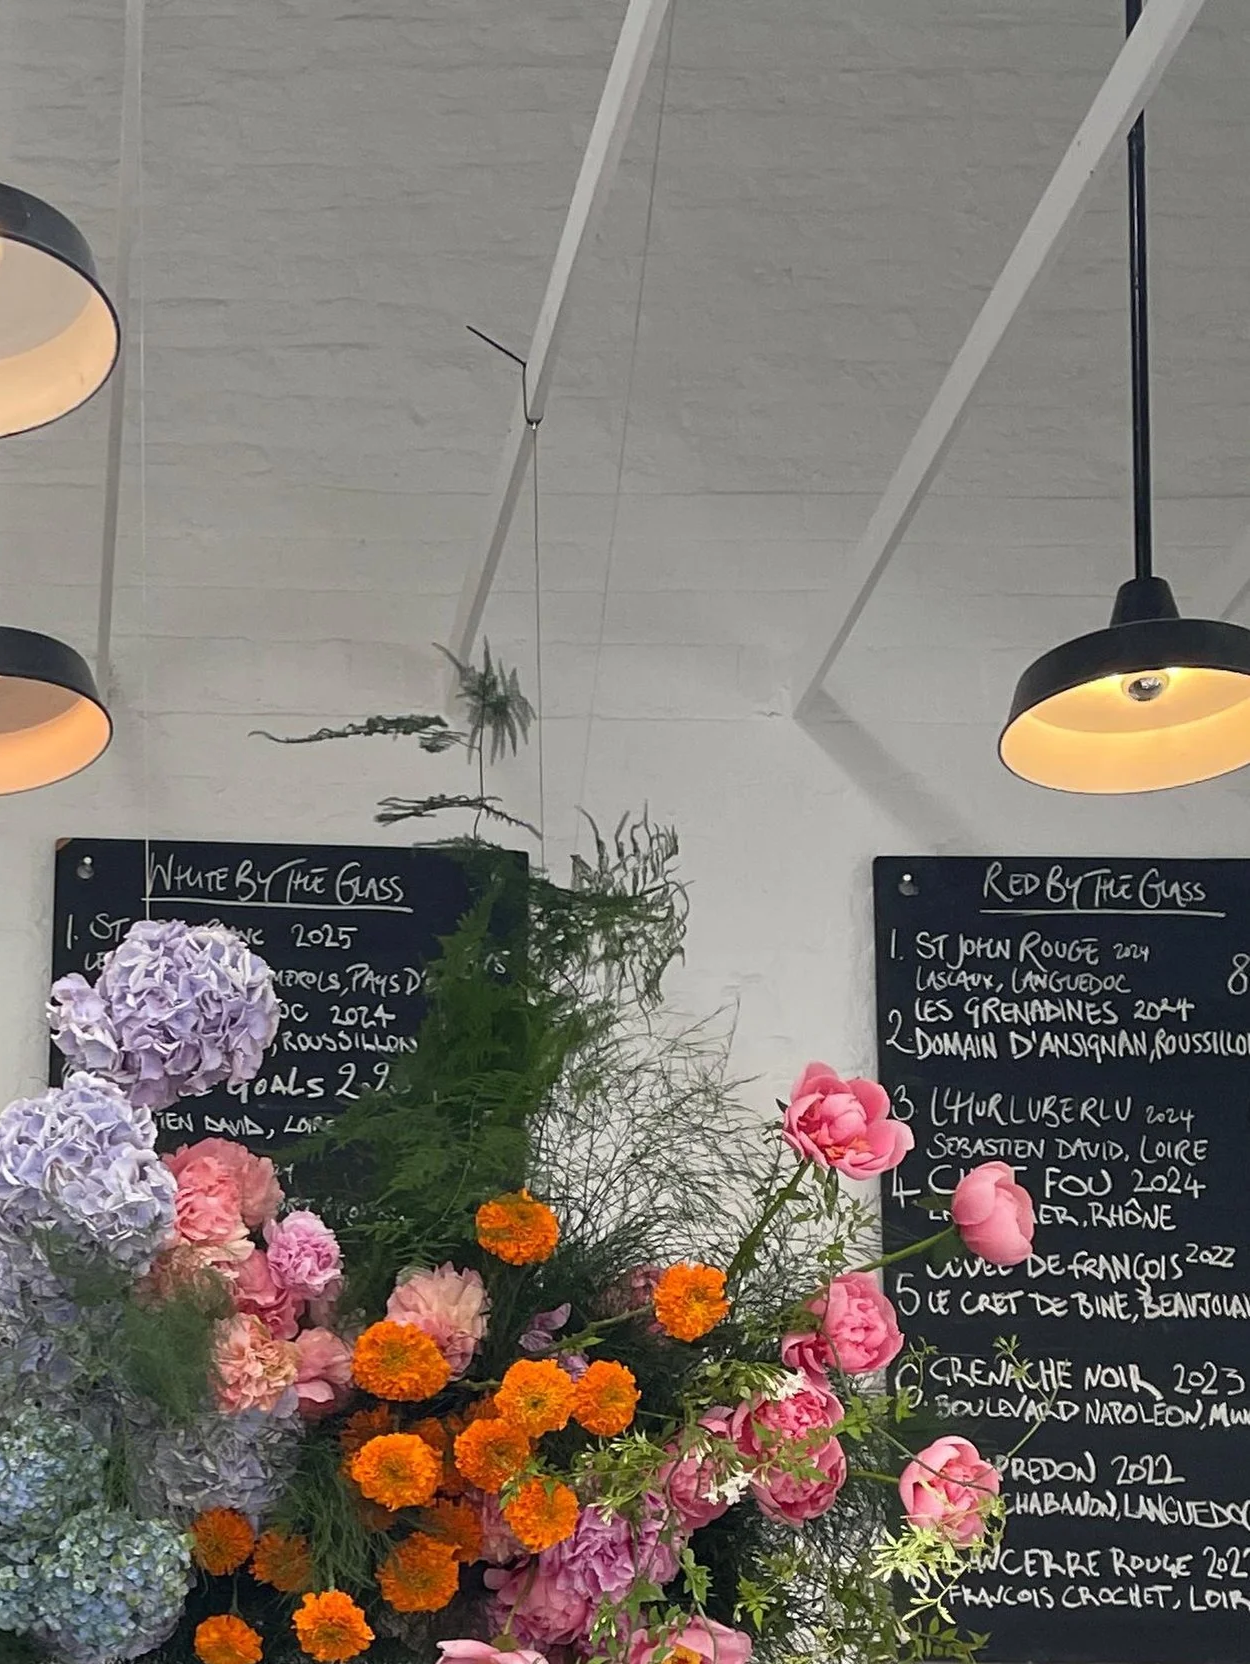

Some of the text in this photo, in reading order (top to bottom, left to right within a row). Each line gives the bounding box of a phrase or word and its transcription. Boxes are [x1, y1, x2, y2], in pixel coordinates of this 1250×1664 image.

[149, 852, 407, 905] WHITE BY THE GLASS
[982, 861, 1207, 911] RED BY THE GLASS
[66, 913, 79, 950] 1.
[89, 912, 131, 943] ST
[290, 923, 358, 951] 2025
[890, 928, 1150, 973] 1. ST JOHN ROUGE 2024
[346, 962, 401, 998] PAYS
[1011, 965, 1132, 997] LANGUEDOC
[329, 1003, 397, 1029] 2024
[914, 996, 1196, 1029] LES GRENADINES 2024
[280, 1029, 419, 1055] ROUSSILLON
[915, 1027, 999, 1061] DOMAIN
[1153, 1028, 1250, 1060] ROUSSILLO
[203, 1113, 275, 1140] DAVID,
[1145, 1104, 1196, 1133] 2024
[926, 1132, 1210, 1167] SEBASTIEN DAVID, LOIRE
[1044, 1168, 1112, 1199] FOU
[1130, 1166, 1207, 1199] 2024
[1087, 1198, 1178, 1232] RHÔNE
[895, 1273, 921, 1317] 5
[1026, 1255, 1066, 1279] DE
[1184, 1243, 1237, 1268] 2022
[927, 1289, 1139, 1324] LE CRET DE BINE,
[930, 1357, 1246, 1401] GRENACHE NOIR 2023
[936, 1394, 1080, 1424] BOULEVARD
[1084, 1398, 1207, 1431] NAPOLEON,
[1110, 1454, 1186, 1486] 2022
[969, 1549, 1101, 1578] ANCERRE
[1111, 1549, 1194, 1579] ROUGE
[948, 1584, 1056, 1609] FRANCOIS
[1061, 1583, 1181, 1610] CROCHET,
